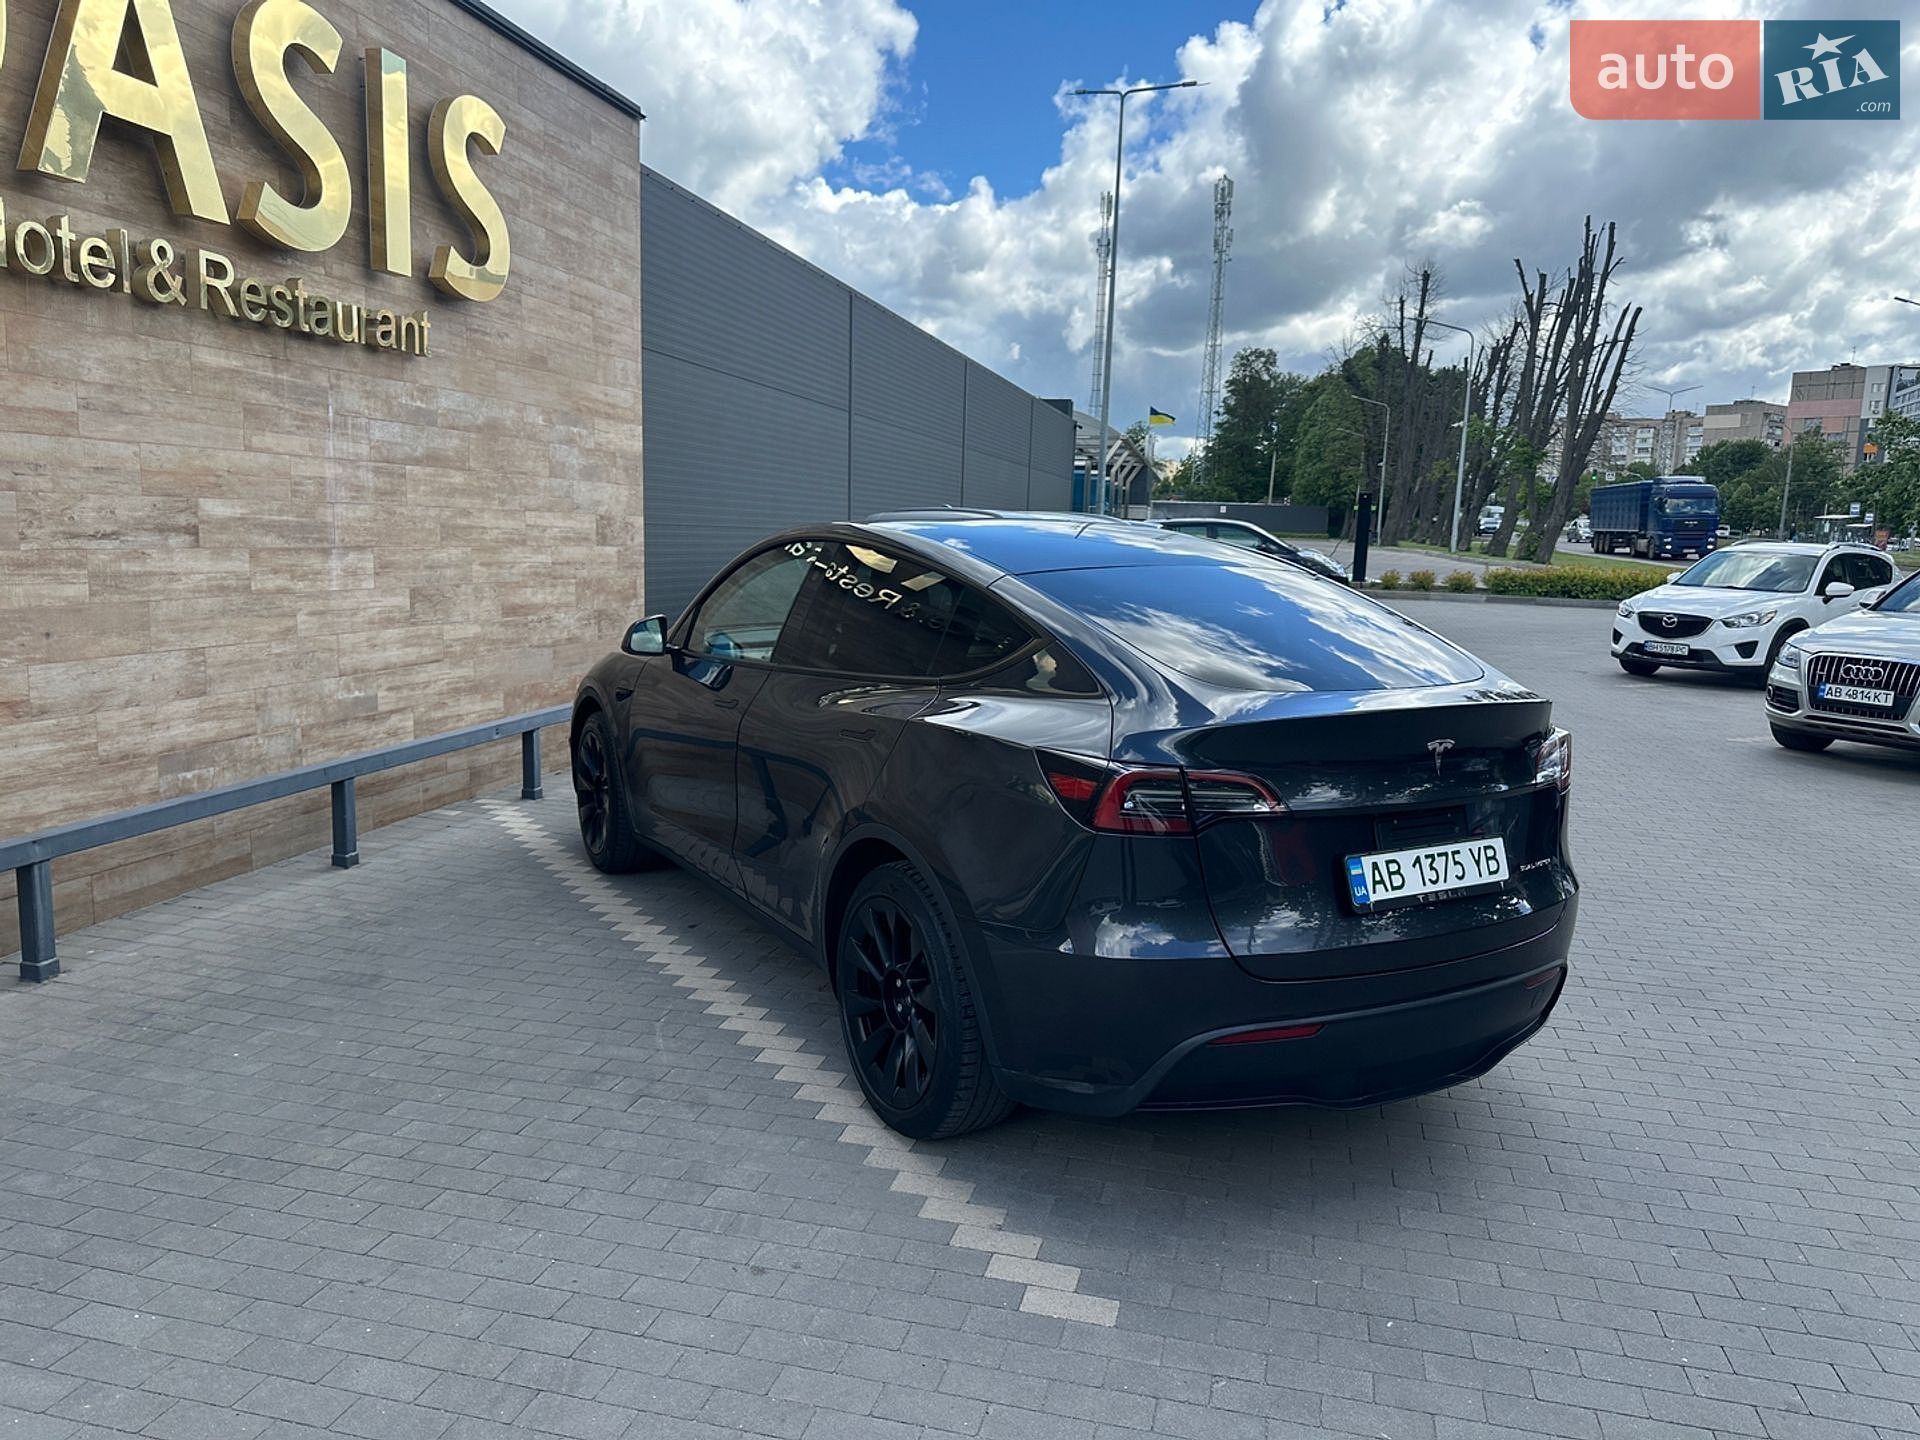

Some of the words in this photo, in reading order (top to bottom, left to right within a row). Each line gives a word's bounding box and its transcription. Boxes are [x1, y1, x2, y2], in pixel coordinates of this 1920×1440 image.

[0, 0, 511, 302] ASIS
[0, 196, 131, 294] otel
[147, 238, 188, 306] &
[198, 249, 432, 358] Restaurant
[1826, 686, 1842, 698] AB
[1873, 692, 1892, 704] KT
[1354, 886, 1367, 896] UA
[1371, 858, 1406, 895] AB
[1411, 849, 1466, 887] 1375
[1468, 844, 1500, 878] YB
